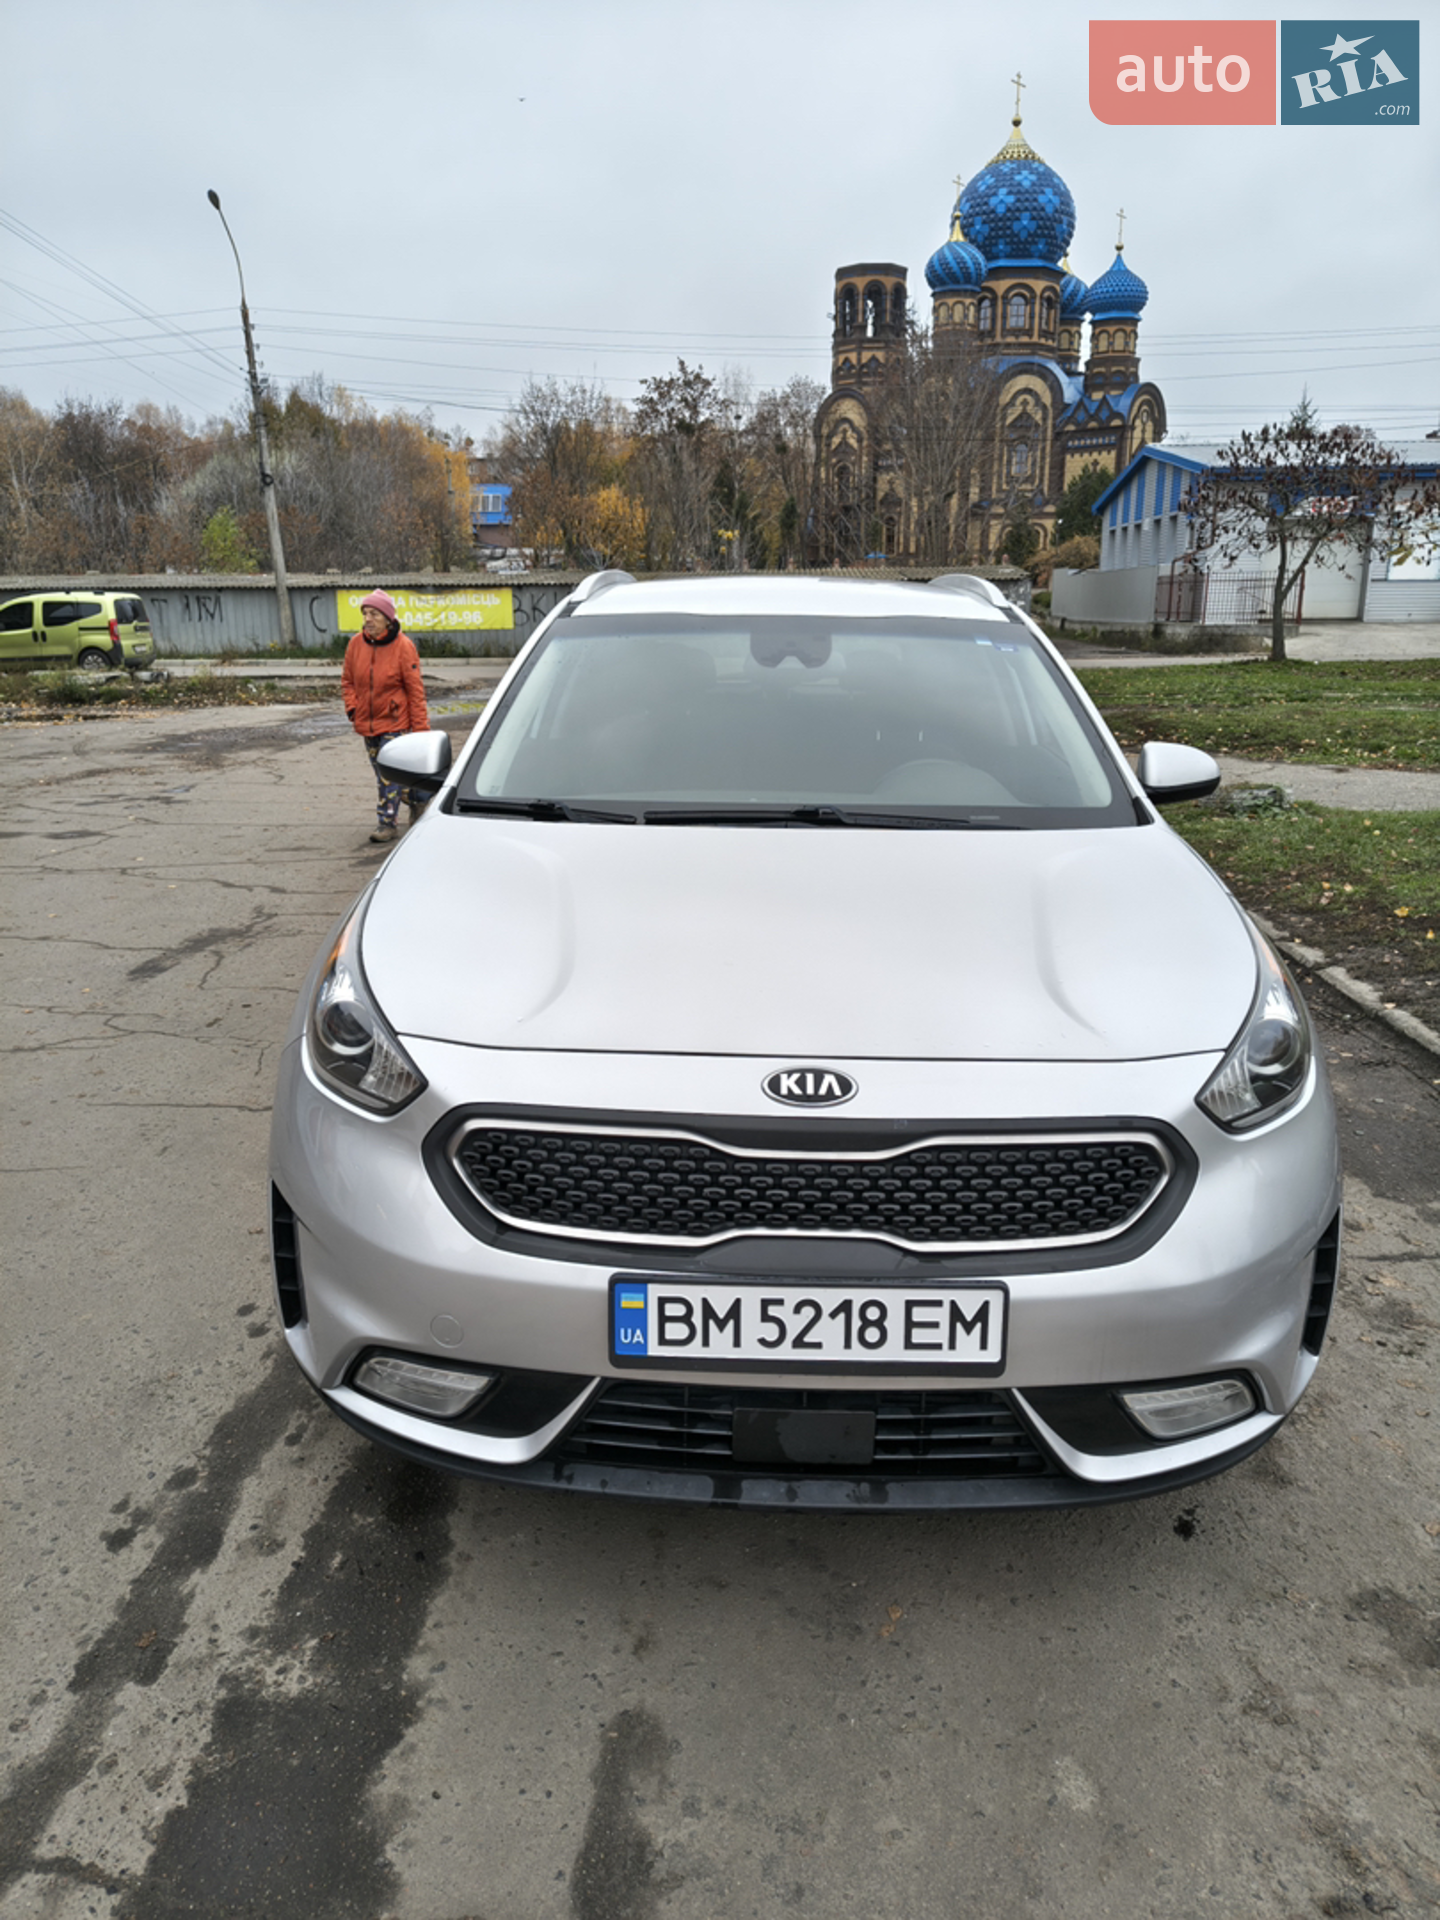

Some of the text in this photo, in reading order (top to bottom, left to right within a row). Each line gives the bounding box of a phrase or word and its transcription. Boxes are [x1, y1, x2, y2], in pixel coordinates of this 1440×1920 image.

[779, 1072, 843, 1096] KIA
[656, 1296, 990, 1351] BM 5218 EM
[620, 1328, 645, 1344] UA
